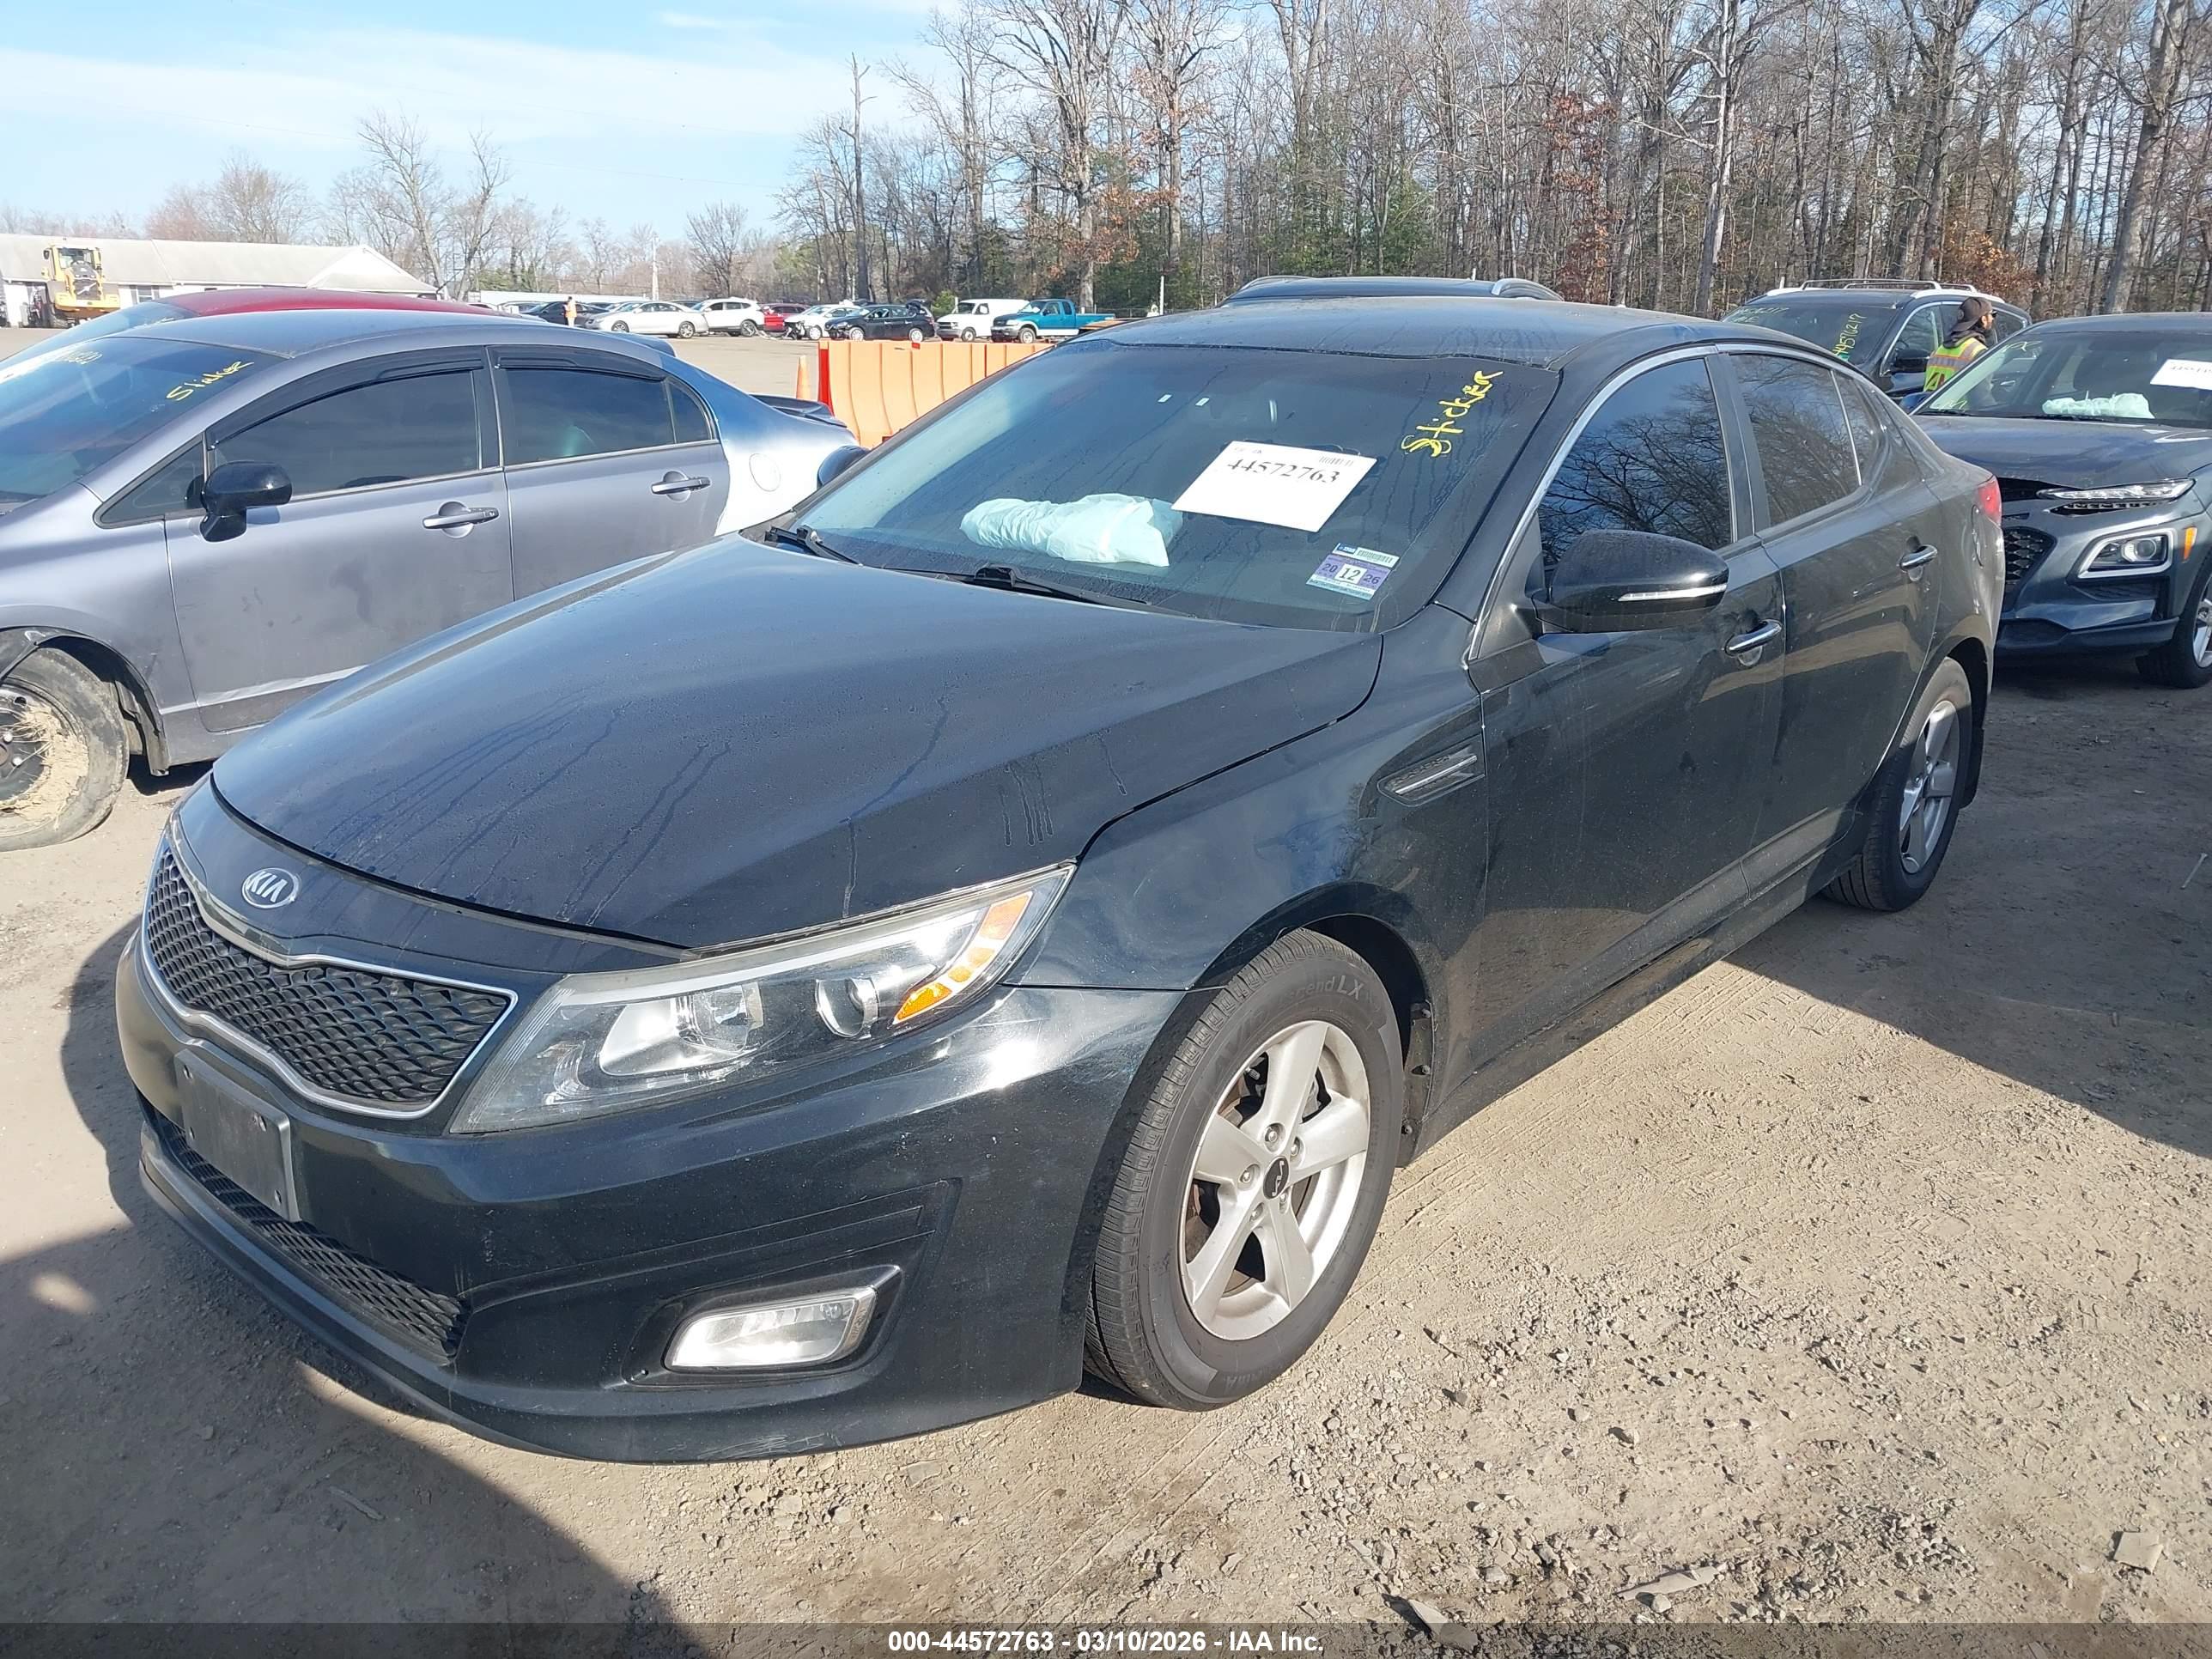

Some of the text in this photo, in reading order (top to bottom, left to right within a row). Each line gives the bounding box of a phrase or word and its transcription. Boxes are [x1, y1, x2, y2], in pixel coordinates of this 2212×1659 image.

[1227, 458, 1341, 484] 44572763
[1322, 562, 1339, 574] 20
[1339, 567, 1361, 581] 12
[1363, 574, 1382, 586] 26
[245, 870, 289, 903] KIA
